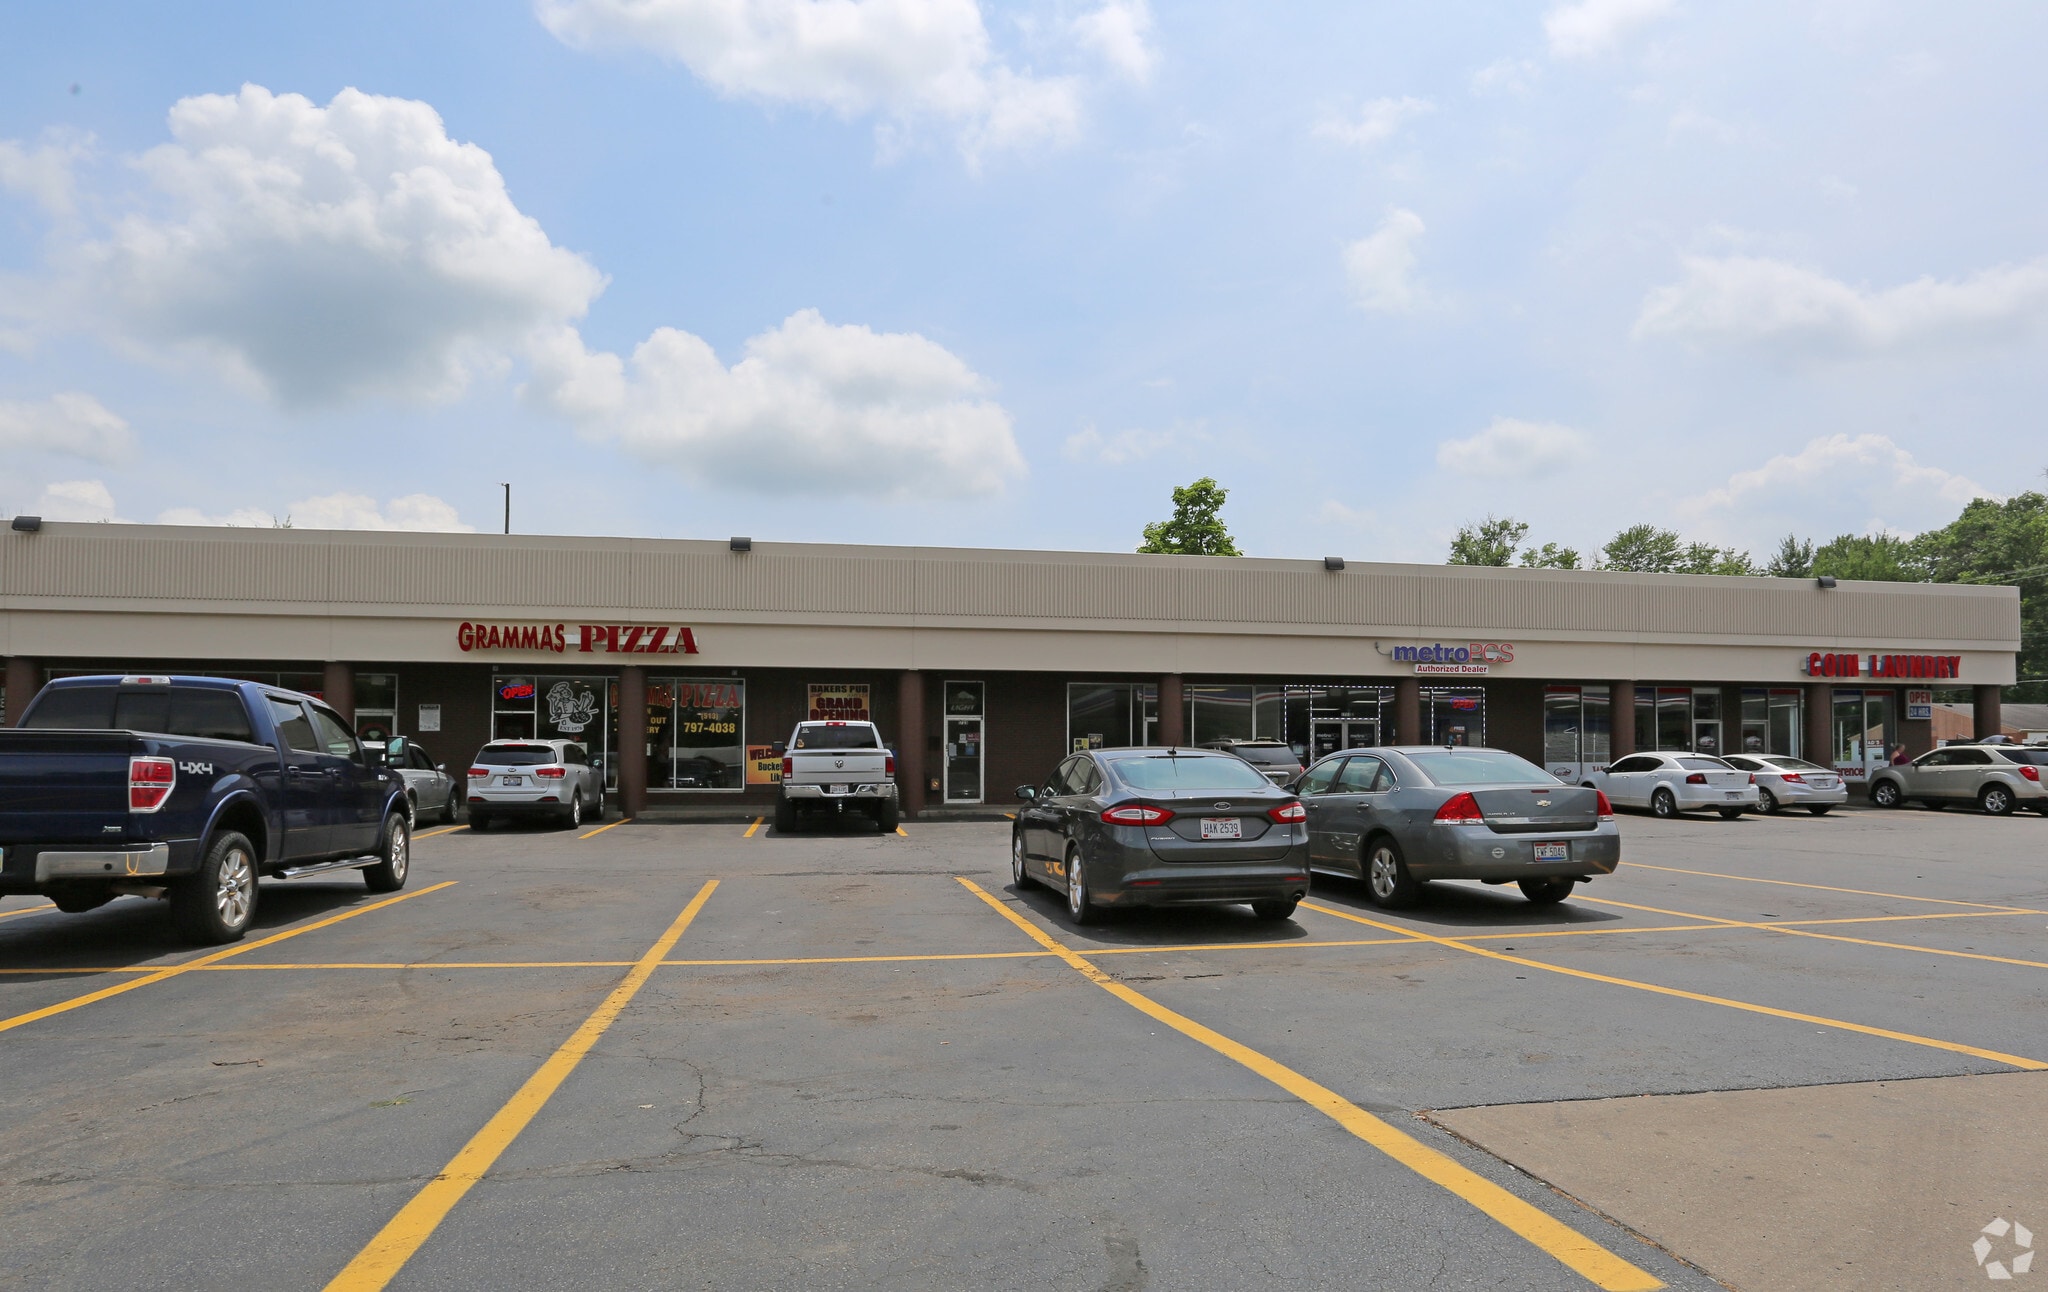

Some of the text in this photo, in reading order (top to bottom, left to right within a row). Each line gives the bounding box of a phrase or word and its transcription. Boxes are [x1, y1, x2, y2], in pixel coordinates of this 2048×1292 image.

[457, 621, 699, 655] GRAMMAS PIZZA
[1393, 643, 1515, 663] metroPCS
[1416, 665, 1488, 673] Authorized Dealer
[1805, 652, 1962, 679] COIN LAUNDRY
[502, 684, 534, 700] OPEN
[679, 683, 741, 709] PIZZA
[1909, 691, 1932, 704] OPEN
[815, 697, 863, 710] GRAND
[650, 717, 667, 725] OUT
[809, 708, 869, 721] OPENING
[683, 722, 736, 734] 797-4038
[179, 761, 214, 775] 4X4
[1203, 822, 1239, 834] HAK 2539
